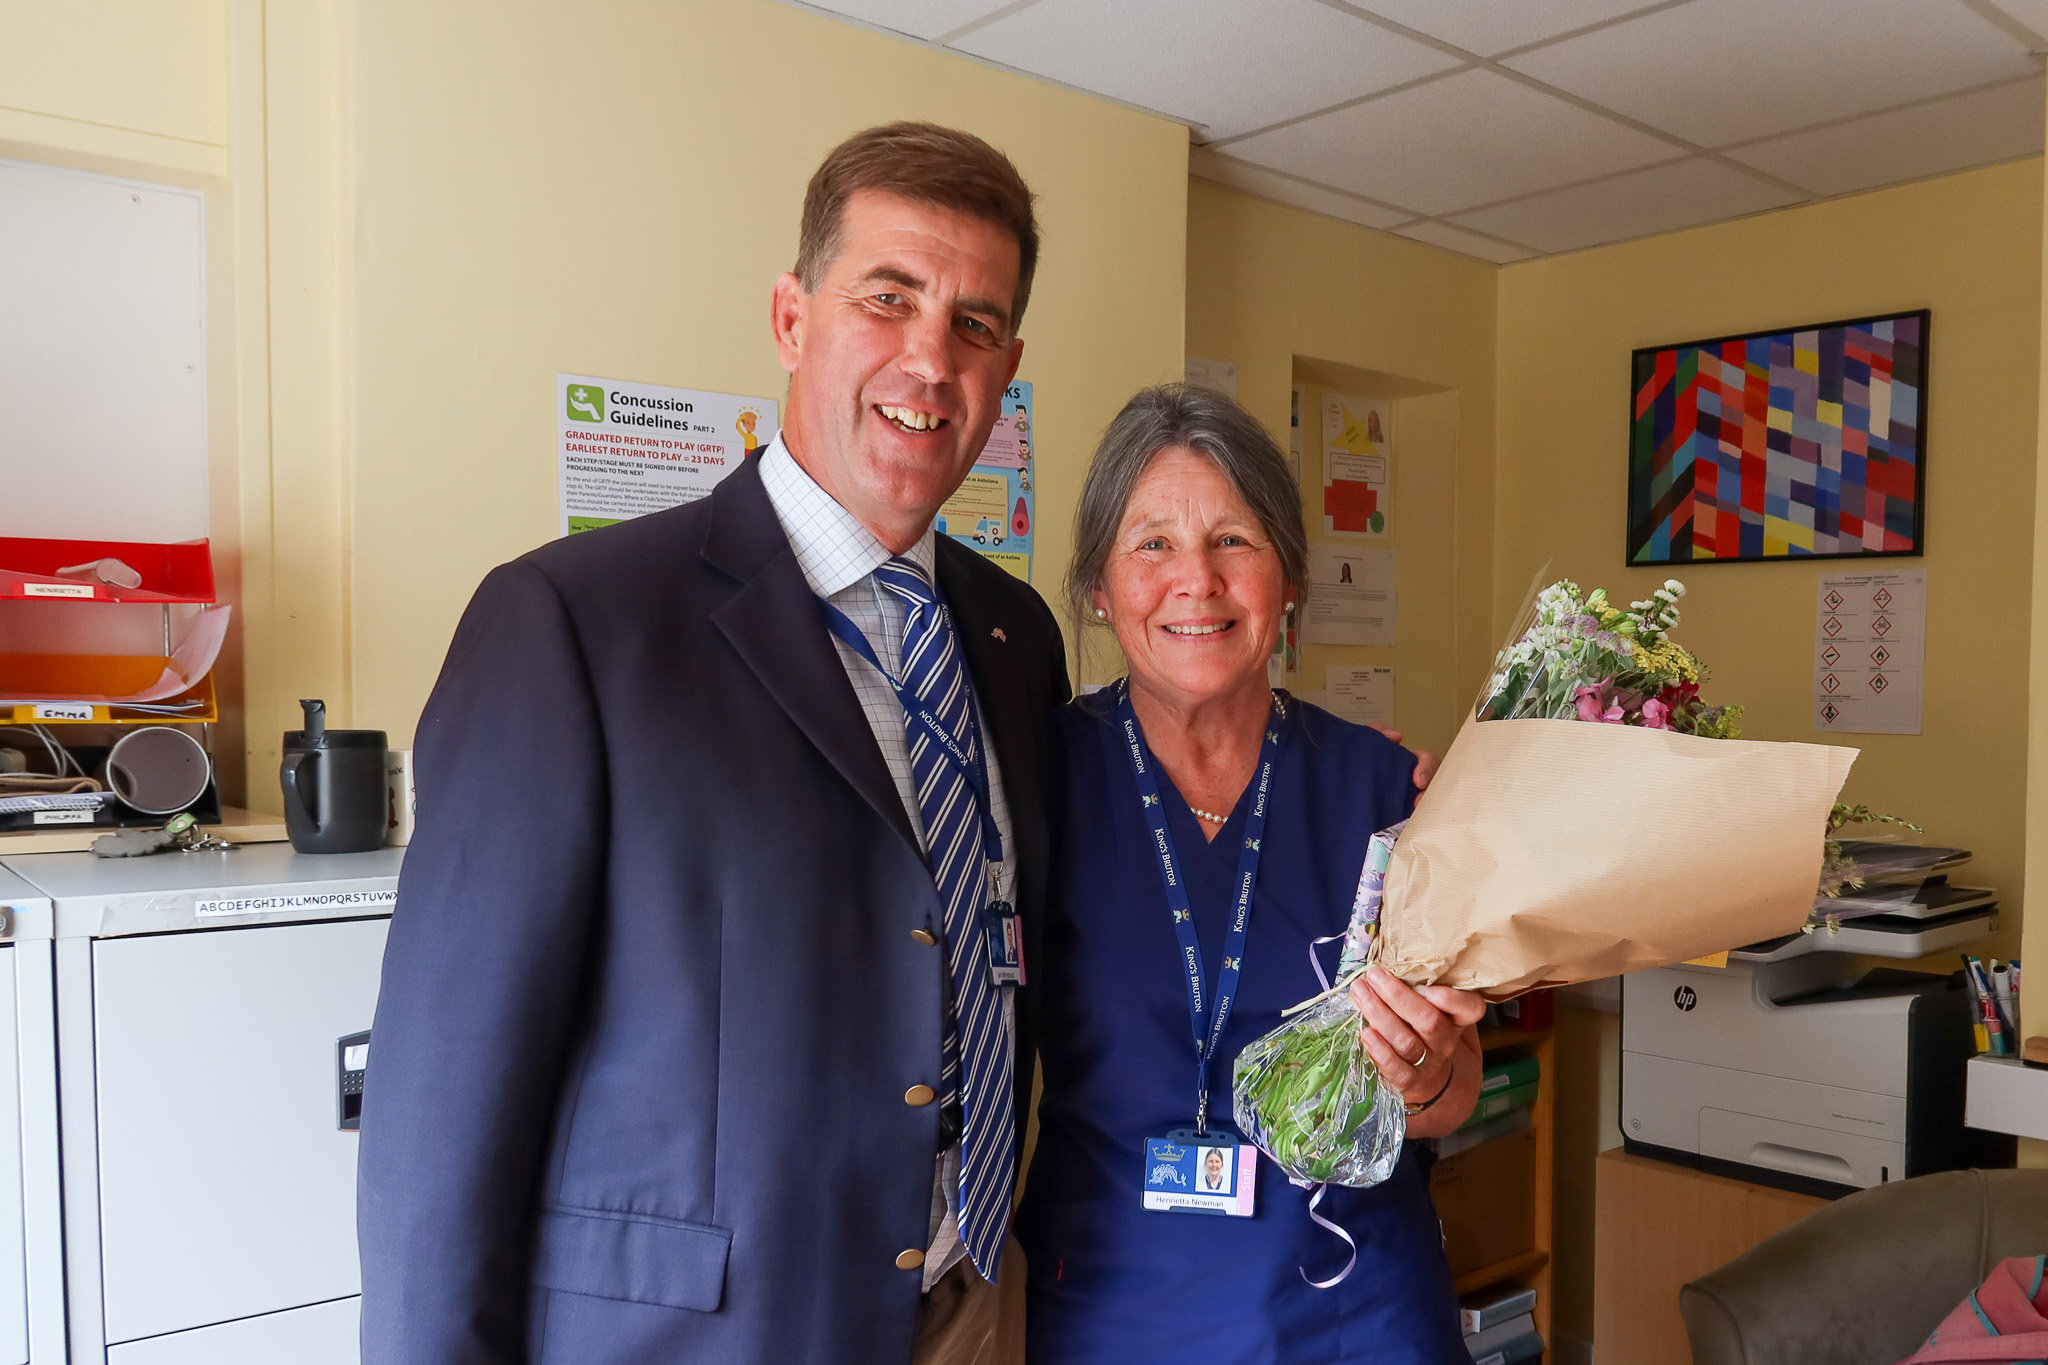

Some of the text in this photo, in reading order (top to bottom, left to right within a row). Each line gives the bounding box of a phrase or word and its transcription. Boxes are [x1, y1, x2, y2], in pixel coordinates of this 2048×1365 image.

[610, 392, 694, 413] Concussion
[610, 410, 688, 430] Guidelines
[694, 425, 710, 433] PART
[566, 430, 725, 454] GRADUATED RETURN TO PLAY (GRTP)
[566, 443, 608, 454] EARLIEST
[610, 447, 645, 458] RETURN
[647, 451, 659, 459] TO
[660, 452, 682, 461] PLAY
[692, 455, 701, 463] 23
[703, 456, 725, 465] DAYS
[566, 464, 608, 473] PROGRESSING
[584, 458, 617, 466] STEP/STAGE
[44, 710, 87, 719] EMMA
[919, 710, 968, 766] KING'S BRUTON
[1124, 719, 1145, 774] KING'S BRUTON
[1254, 762, 1271, 817] KING'S BRUTON
[1155, 828, 1176, 886] KING'S BRUTON
[1233, 871, 1252, 933] KING'S BRUTON
[1186, 946, 1202, 1012] KING'S BRUTON
[1677, 985, 1694, 1011] hp
[1214, 996, 1229, 1031] BRUTON
[1242, 1168, 1251, 1191] Staff
[1156, 1196, 1224, 1207] Henrietta Newman
